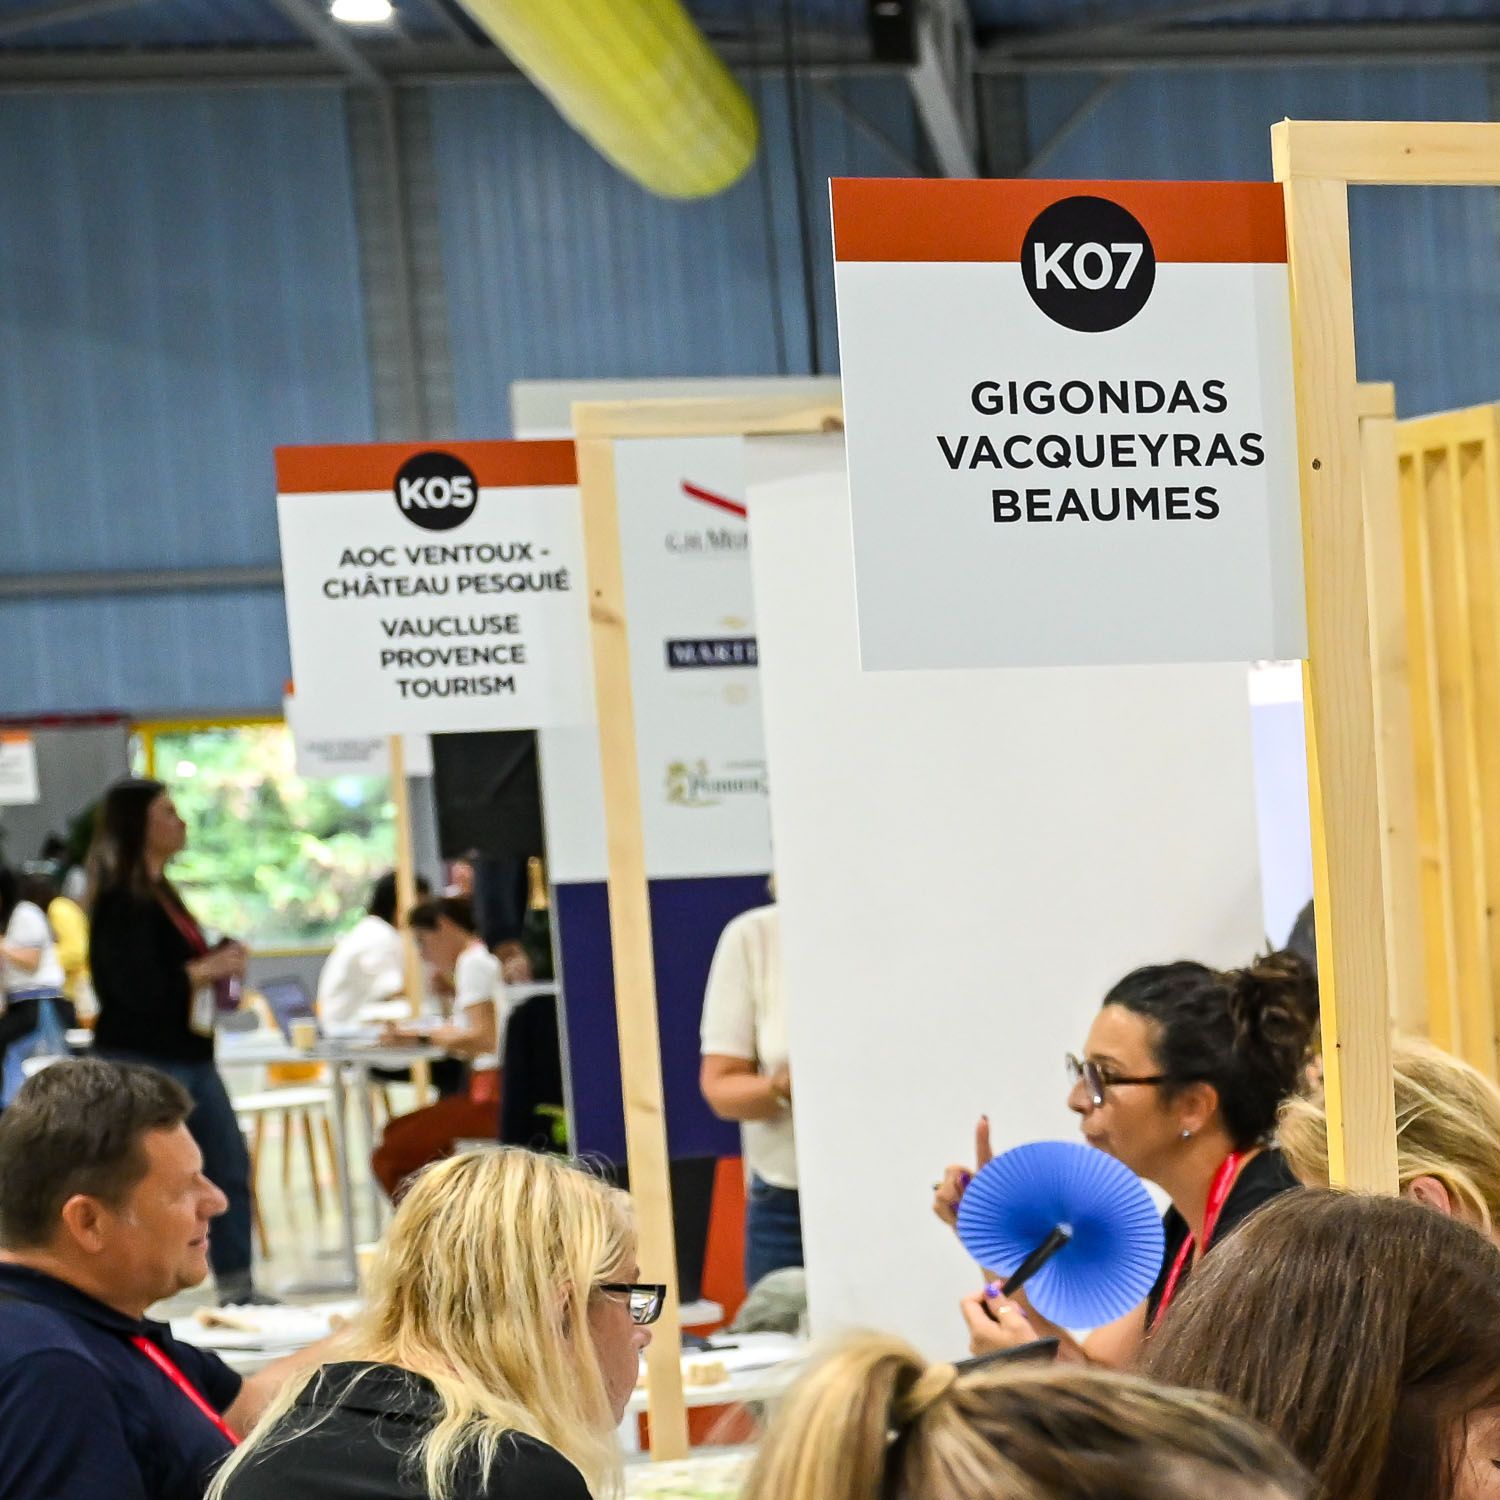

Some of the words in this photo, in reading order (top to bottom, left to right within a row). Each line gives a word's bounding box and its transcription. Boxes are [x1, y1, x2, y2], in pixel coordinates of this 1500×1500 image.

[1034, 241, 1144, 291] K07
[971, 379, 1228, 416] GIGONDAS
[936, 432, 1265, 471] VACQUEYRAS
[398, 476, 474, 511] K05
[991, 485, 1220, 523] BEAUMES
[339, 546, 396, 568] AOC
[405, 542, 533, 566] VENTOUX
[322, 574, 449, 600] CHÂTEAU
[456, 566, 570, 595] PESQUIÉ
[380, 613, 519, 638] VAUCLUSE
[379, 643, 526, 669] PROVENCE
[396, 675, 516, 699] TOURISM
